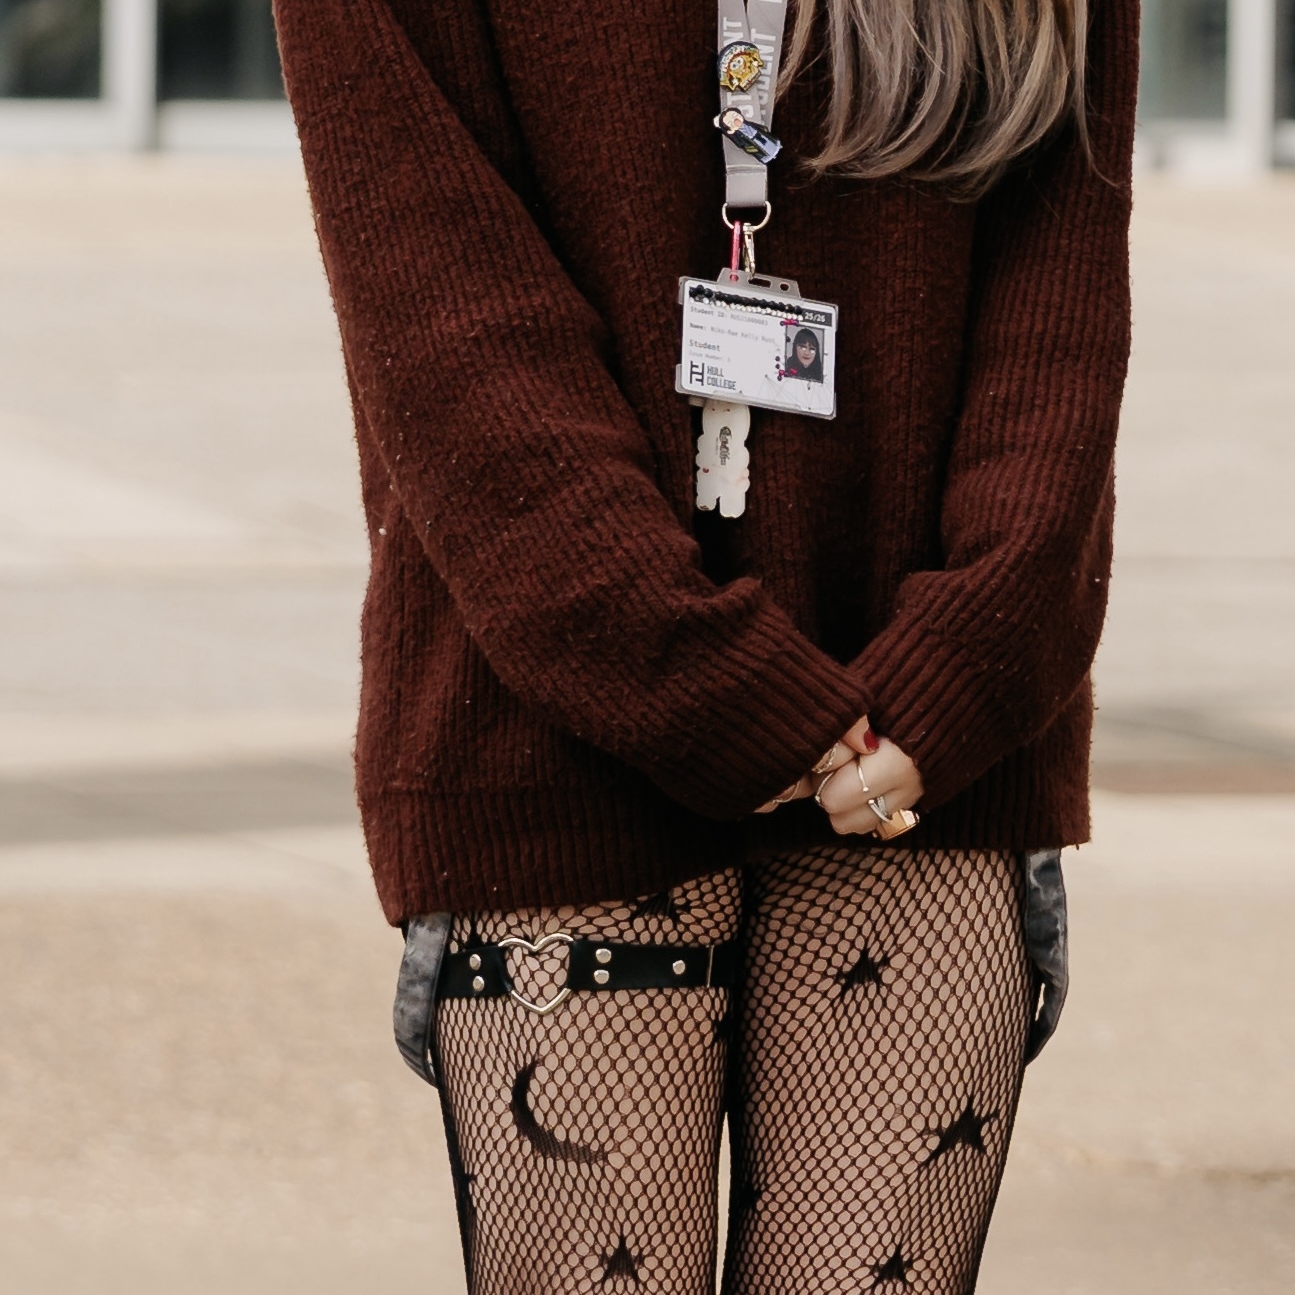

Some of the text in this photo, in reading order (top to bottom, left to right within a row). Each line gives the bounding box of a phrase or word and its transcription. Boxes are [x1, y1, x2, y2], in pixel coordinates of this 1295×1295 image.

[688, 338, 721, 353] Student
[706, 364, 725, 378] HULL
[706, 376, 737, 392] COLLEGE
